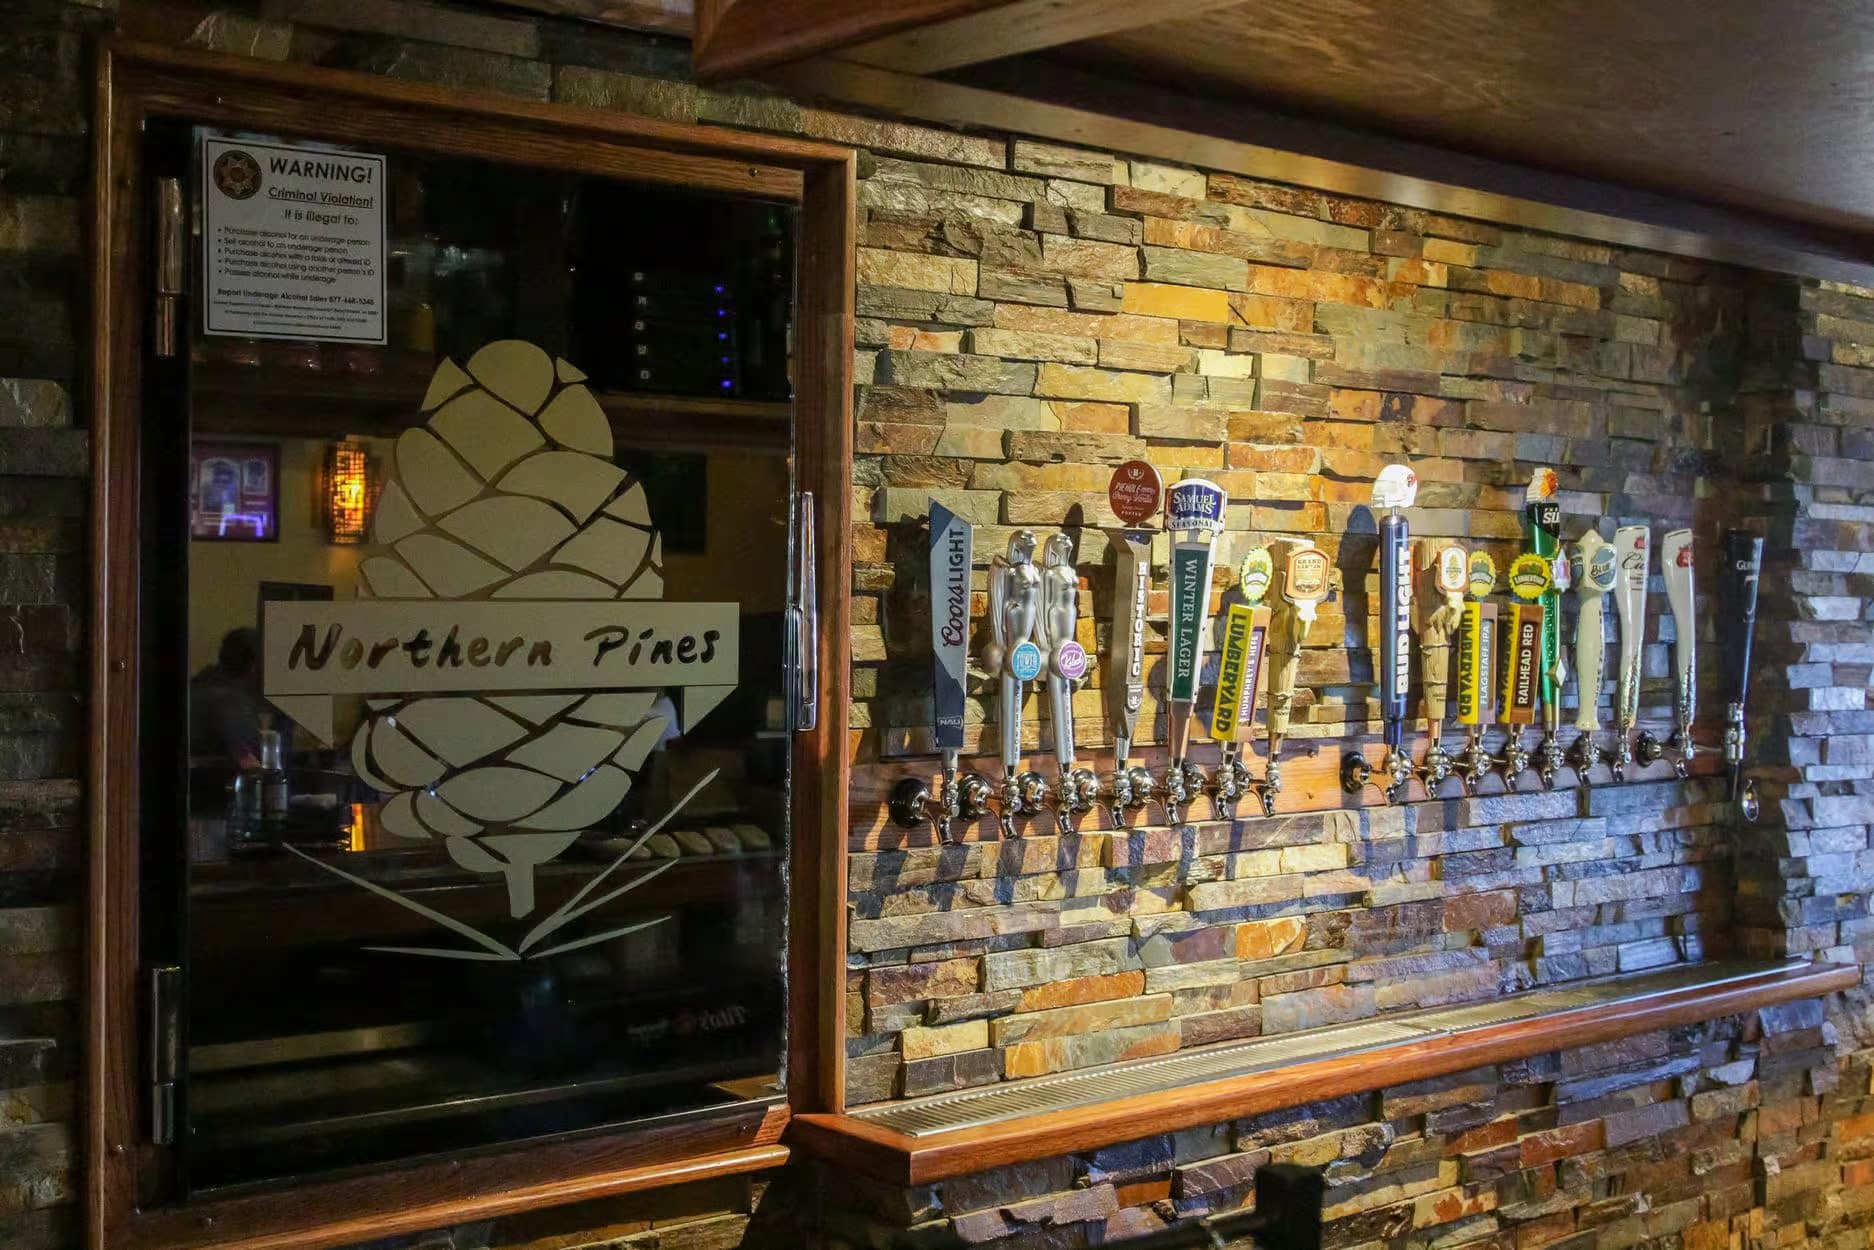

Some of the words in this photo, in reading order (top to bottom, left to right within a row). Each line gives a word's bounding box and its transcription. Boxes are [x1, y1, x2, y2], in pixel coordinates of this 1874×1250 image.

[268, 186, 317, 201] Criminal
[320, 192, 374, 208] Violation!
[269, 156, 373, 184] WARNING!
[284, 209, 292, 219] It
[294, 210, 303, 221] is
[306, 211, 340, 226] illegal
[343, 214, 359, 226] to:
[1173, 491, 1217, 505] SAMUEL
[1175, 502, 1214, 515] ADAMS
[947, 526, 965, 581] LIGHT
[941, 584, 966, 648] Coors
[1180, 559, 1198, 624] WINTER
[1396, 546, 1413, 630] LIGHT
[288, 622, 554, 671] Northern
[583, 624, 721, 668] Pines
[1132, 560, 1148, 677] HISTORIC
[1481, 625, 1491, 644] IPA
[1521, 624, 1534, 645] RED
[1177, 627, 1193, 679] LAGER
[1216, 612, 1247, 734] LUMBERYARD
[1240, 659, 1255, 716] HUMPHREY'S
[1249, 635, 1259, 657] HEFE
[1395, 635, 1409, 694] BUD
[1458, 609, 1474, 717] LUMBERYARD
[1479, 646, 1489, 706] FLAGSTAFF
[1517, 647, 1532, 705] RAILHEAD
